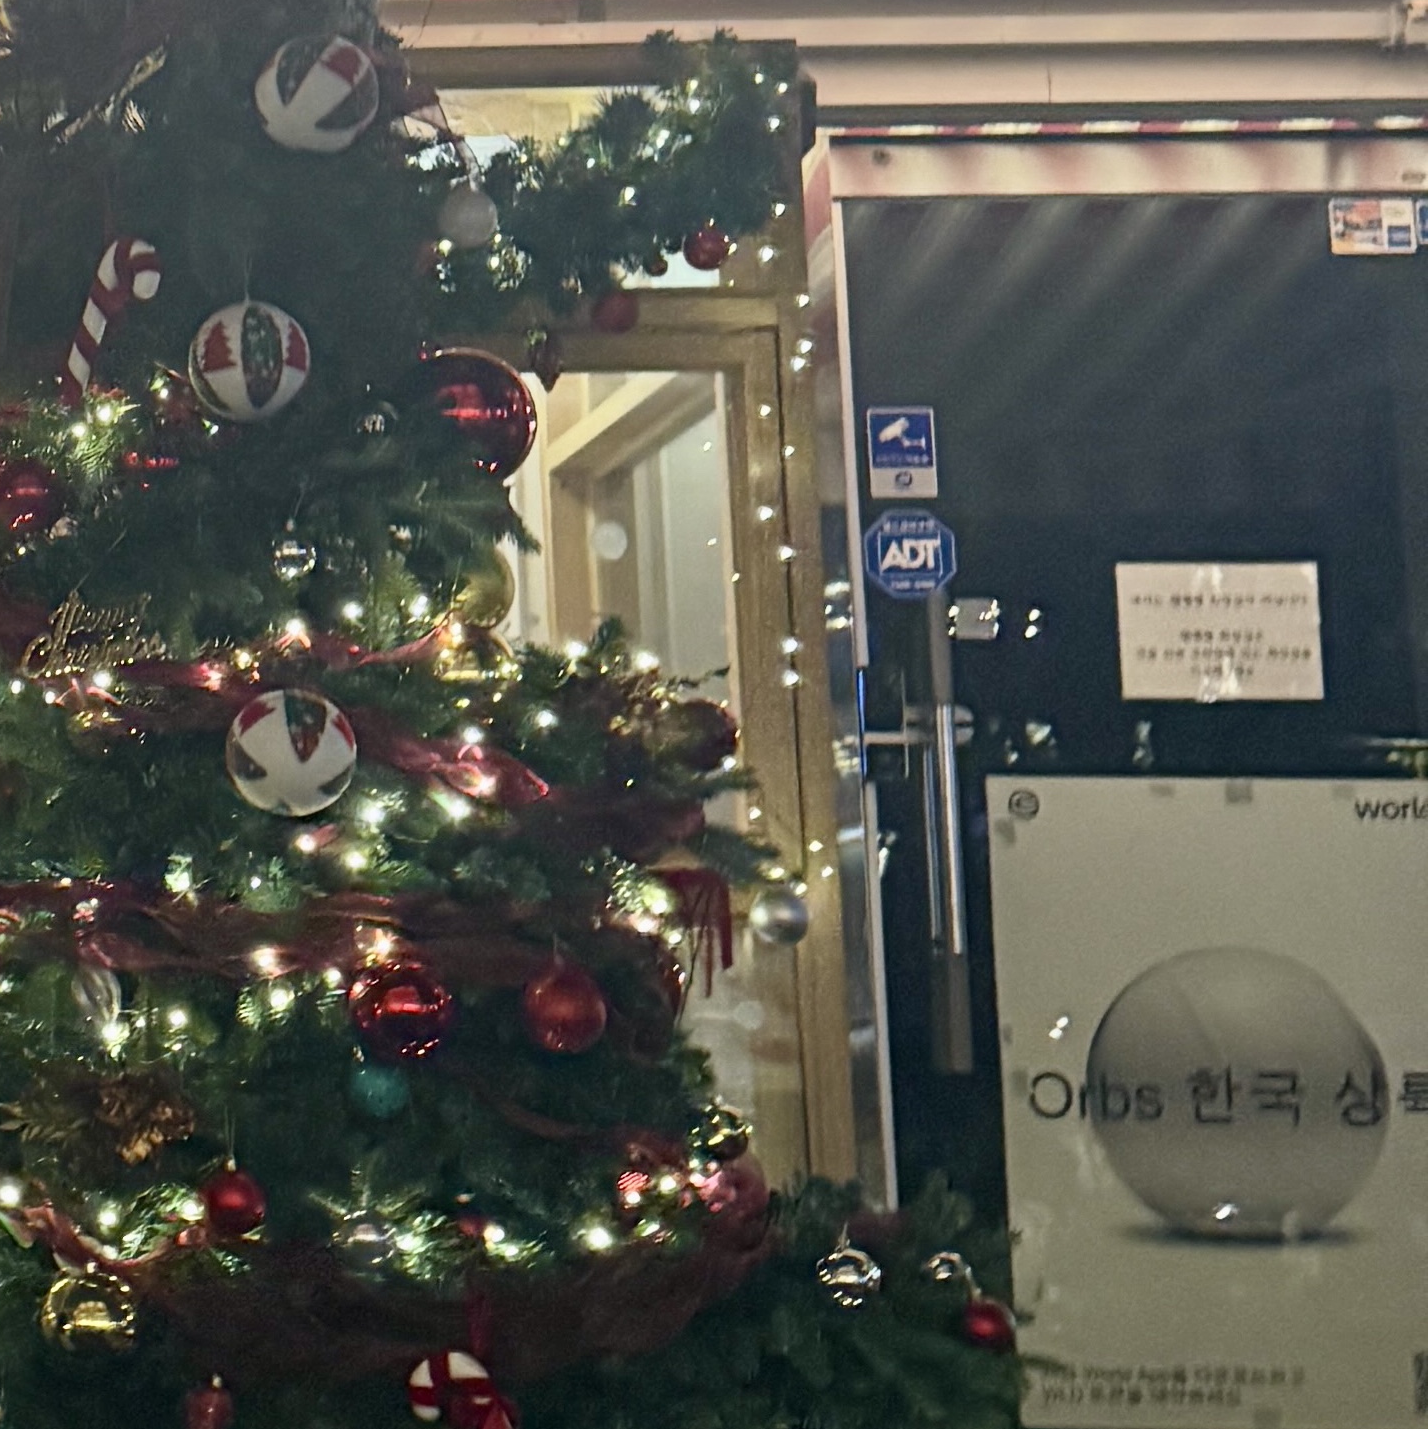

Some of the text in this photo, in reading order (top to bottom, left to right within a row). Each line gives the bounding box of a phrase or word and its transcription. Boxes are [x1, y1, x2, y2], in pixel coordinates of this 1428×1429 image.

[881, 539, 940, 572] ADT
[1031, 1072, 1163, 1120] Orbs
[1189, 1066, 1300, 1128] 한국
